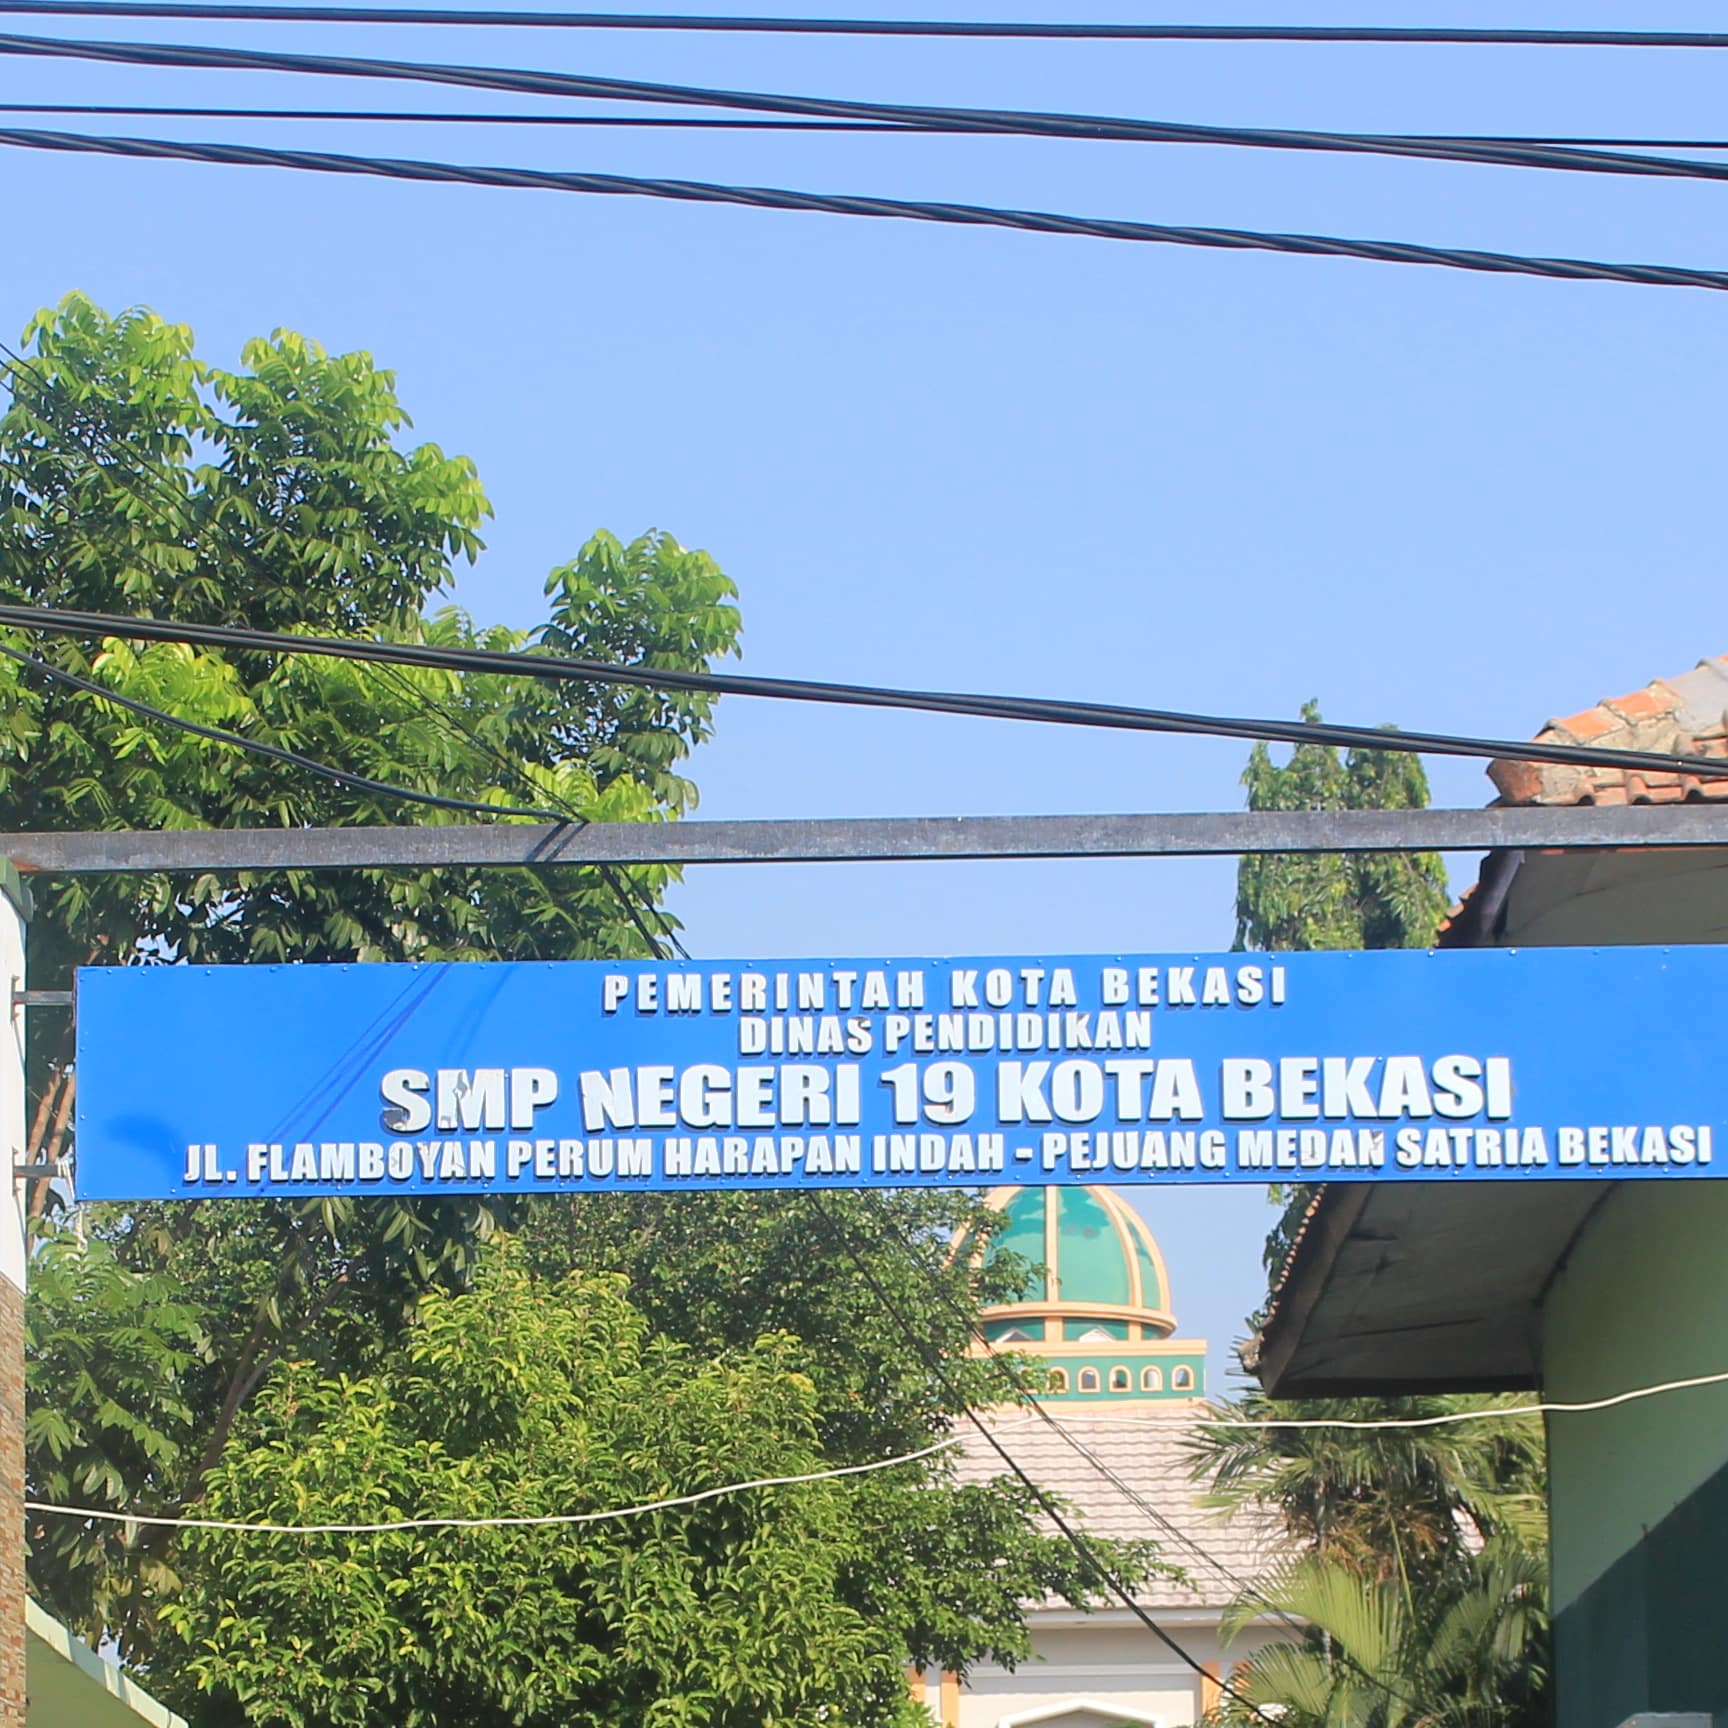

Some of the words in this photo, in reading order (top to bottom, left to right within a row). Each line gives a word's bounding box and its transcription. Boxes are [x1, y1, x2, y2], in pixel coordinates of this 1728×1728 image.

[603, 969, 925, 1013] PEMERINTAH
[952, 967, 1077, 1009] KOTA
[1102, 965, 1286, 1005] BEKASI
[740, 1015, 872, 1054] DINAS
[886, 1011, 1152, 1053] PENDIDIKAN
[381, 1067, 559, 1132] SMP
[579, 1063, 861, 1132] NEGERI
[880, 1061, 974, 1125] 19
[997, 1057, 1204, 1123] KOTA
[1221, 1054, 1512, 1121] BEKASI
[183, 1143, 238, 1182] JL.
[246, 1141, 496, 1181] FLAMBOYAN
[506, 1138, 654, 1178] PERUM
[664, 1134, 862, 1178] HARAPAN
[872, 1132, 1004, 1172] INDAH
[1015, 1147, 1033, 1160] -
[1041, 1129, 1226, 1171] PEJUANG
[1237, 1127, 1386, 1169] MEDAN
[1395, 1126, 1550, 1167] SATRIA
[1557, 1124, 1712, 1165] BEKASI
